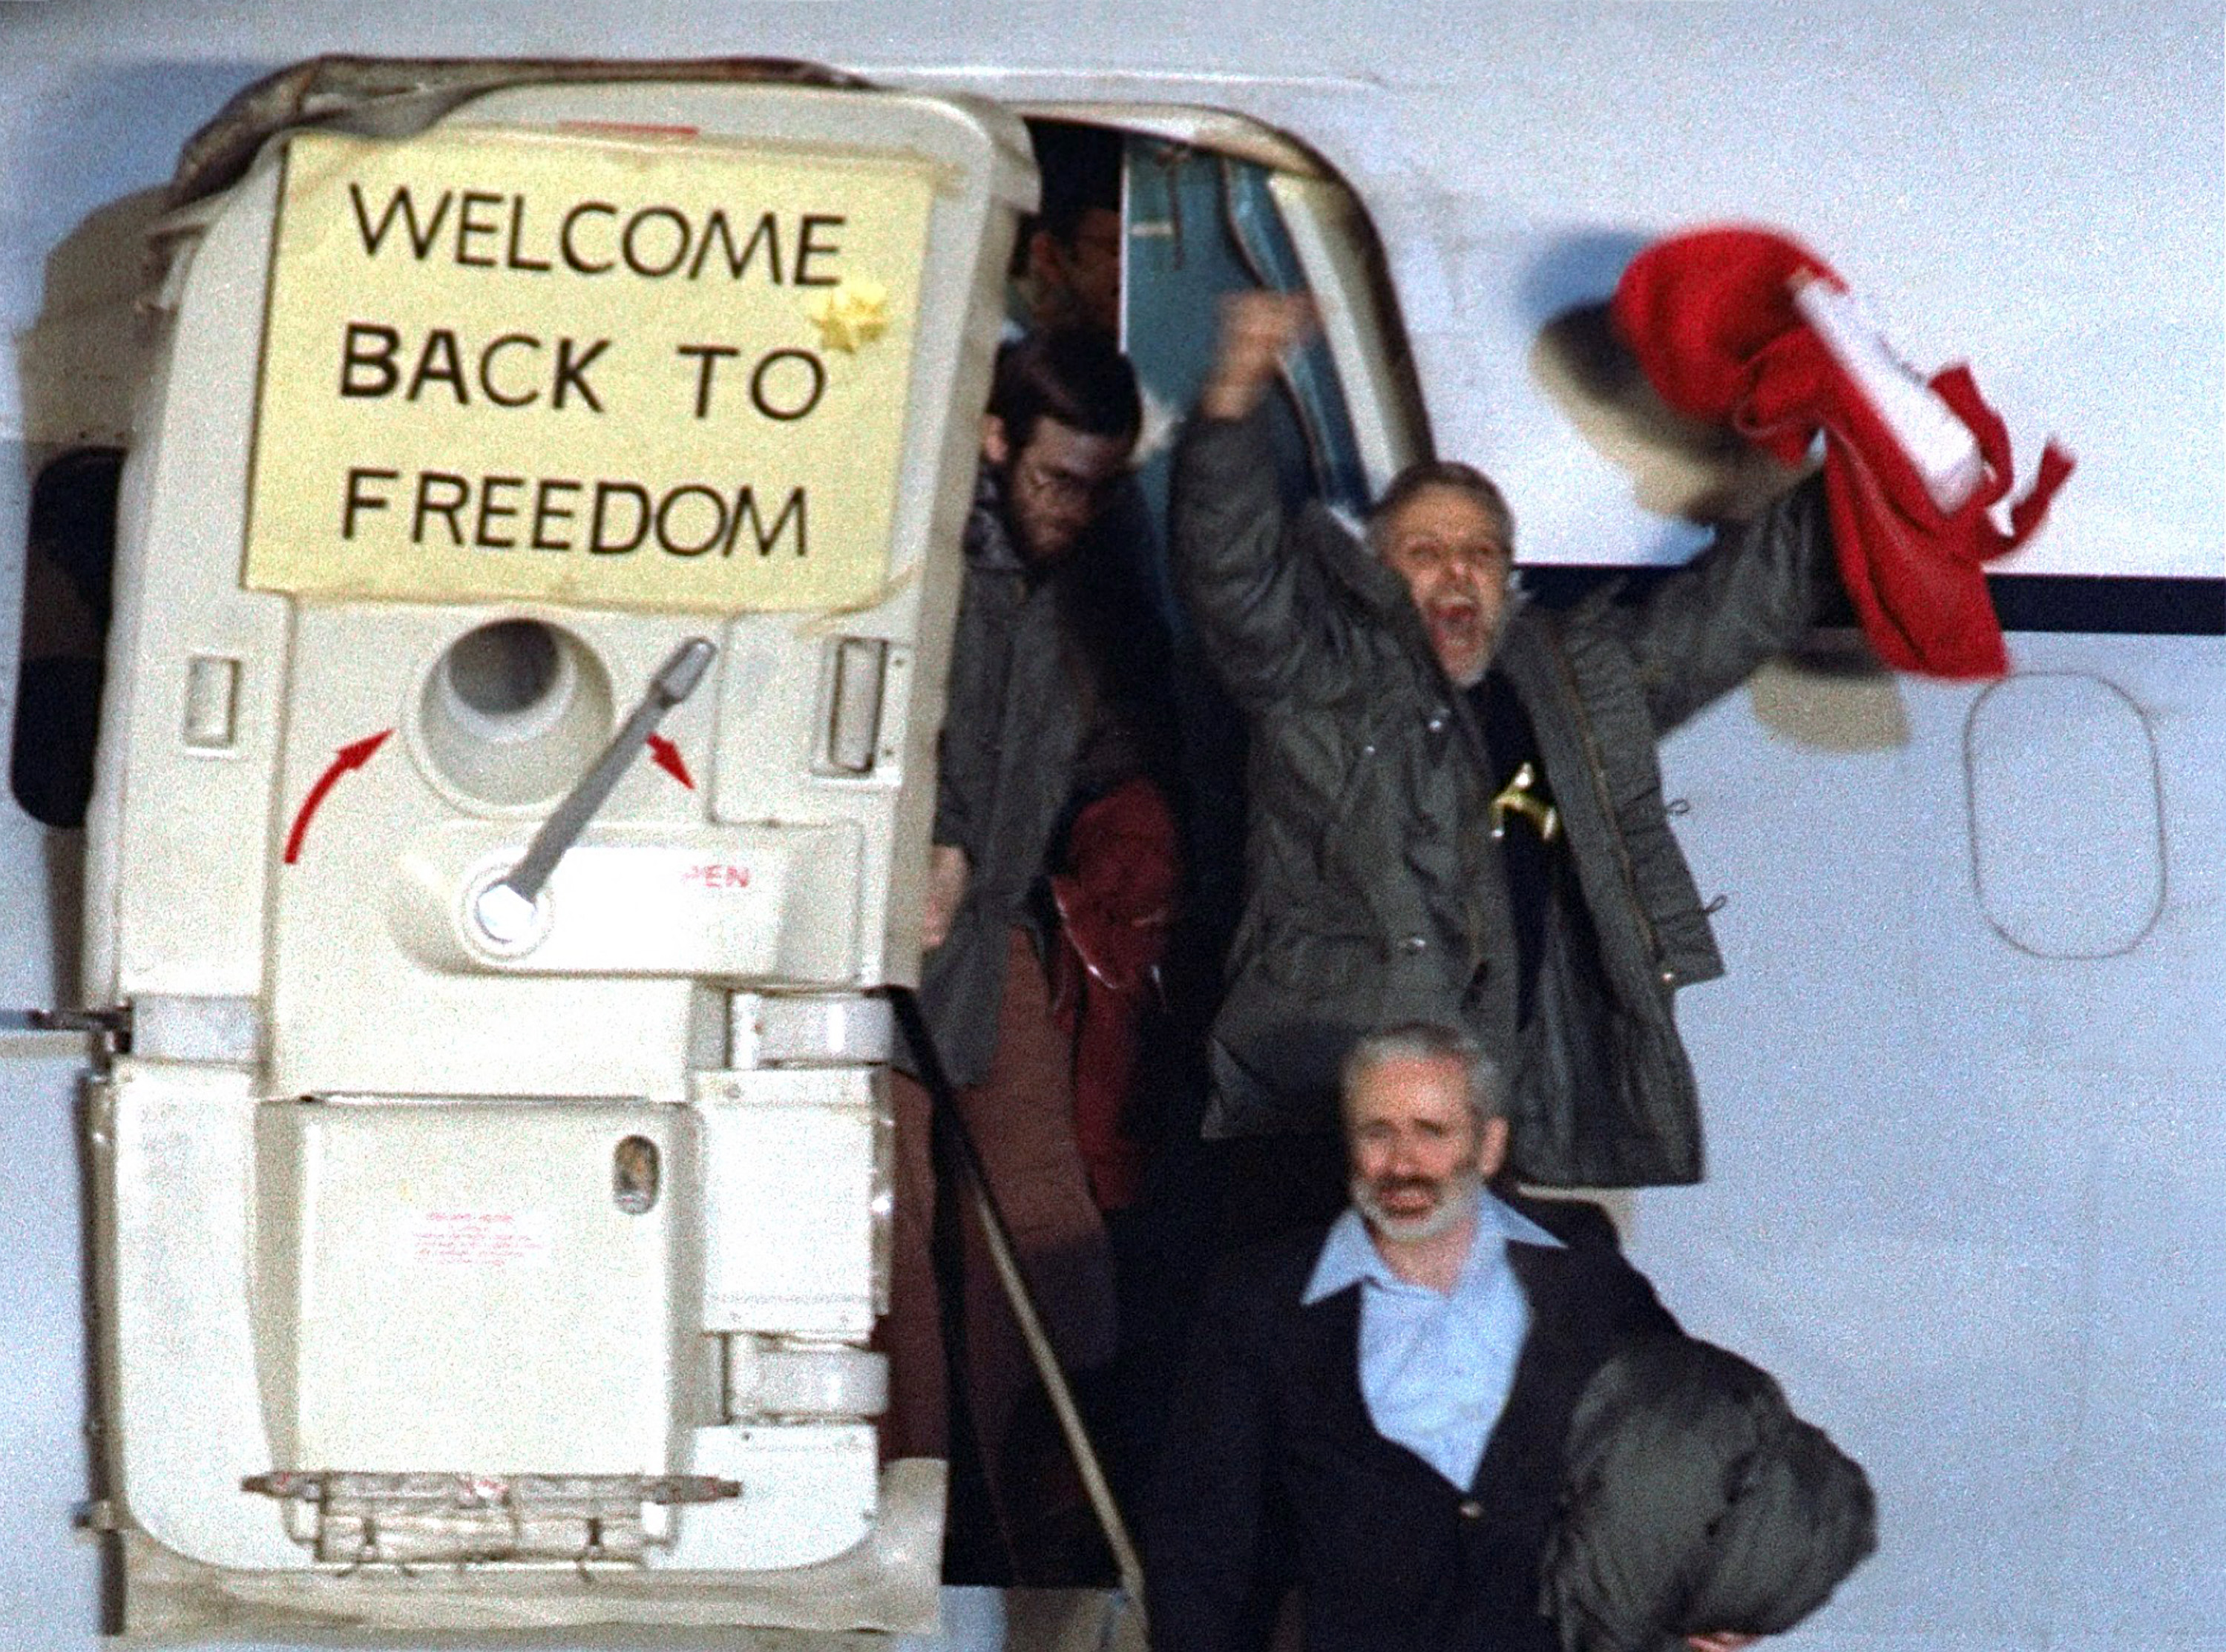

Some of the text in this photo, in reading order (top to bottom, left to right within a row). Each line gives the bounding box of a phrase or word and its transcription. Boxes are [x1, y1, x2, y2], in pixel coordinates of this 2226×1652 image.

[349, 182, 845, 288] WELCOME
[339, 322, 826, 422] BACK TO
[342, 467, 807, 559] FREEDOM
